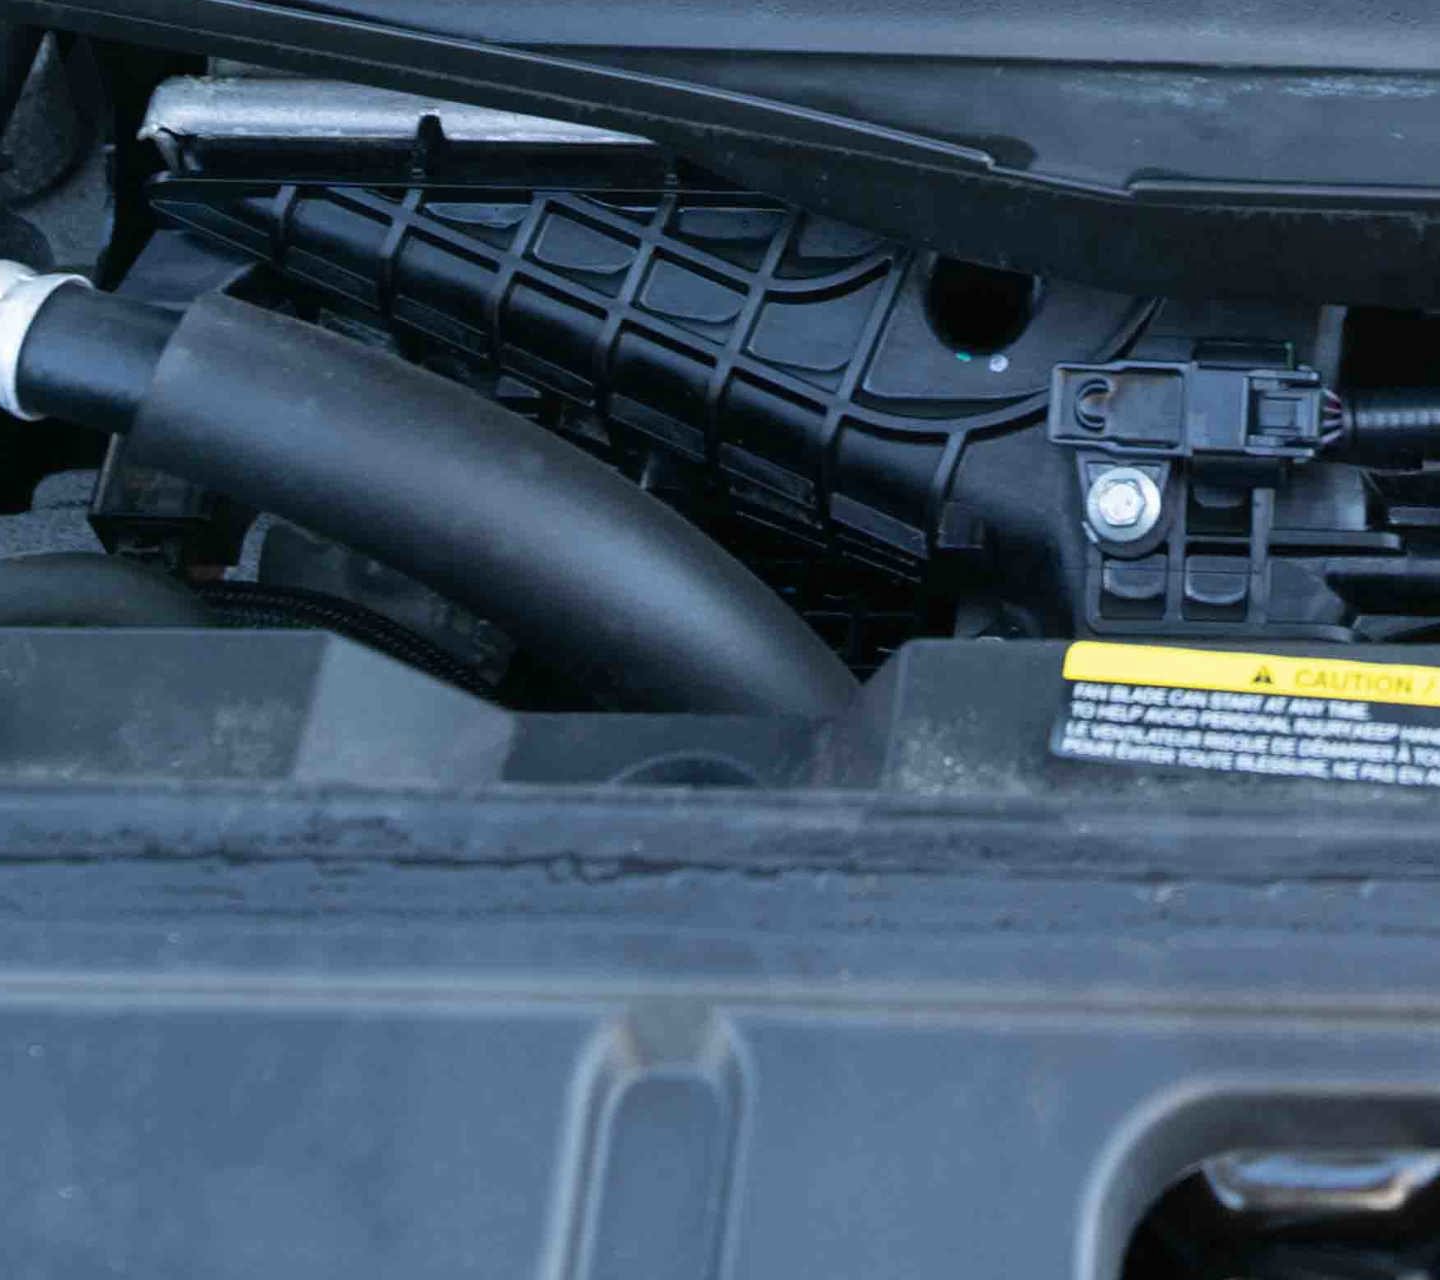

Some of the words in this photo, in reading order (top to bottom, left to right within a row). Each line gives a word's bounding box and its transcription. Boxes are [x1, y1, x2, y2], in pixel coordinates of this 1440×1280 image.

[1073, 682, 1108, 701] FAN
[1110, 684, 1167, 705] BLADE
[1168, 688, 1208, 708] CAN
[1295, 669, 1413, 693] CAUTION
[1071, 701, 1096, 720] TO
[1096, 703, 1144, 723] HELP
[1143, 706, 1200, 727] AVOID
[1198, 709, 1292, 734] PERSONAL
[1065, 719, 1089, 739] LE
[1269, 735, 1297, 755] DE
